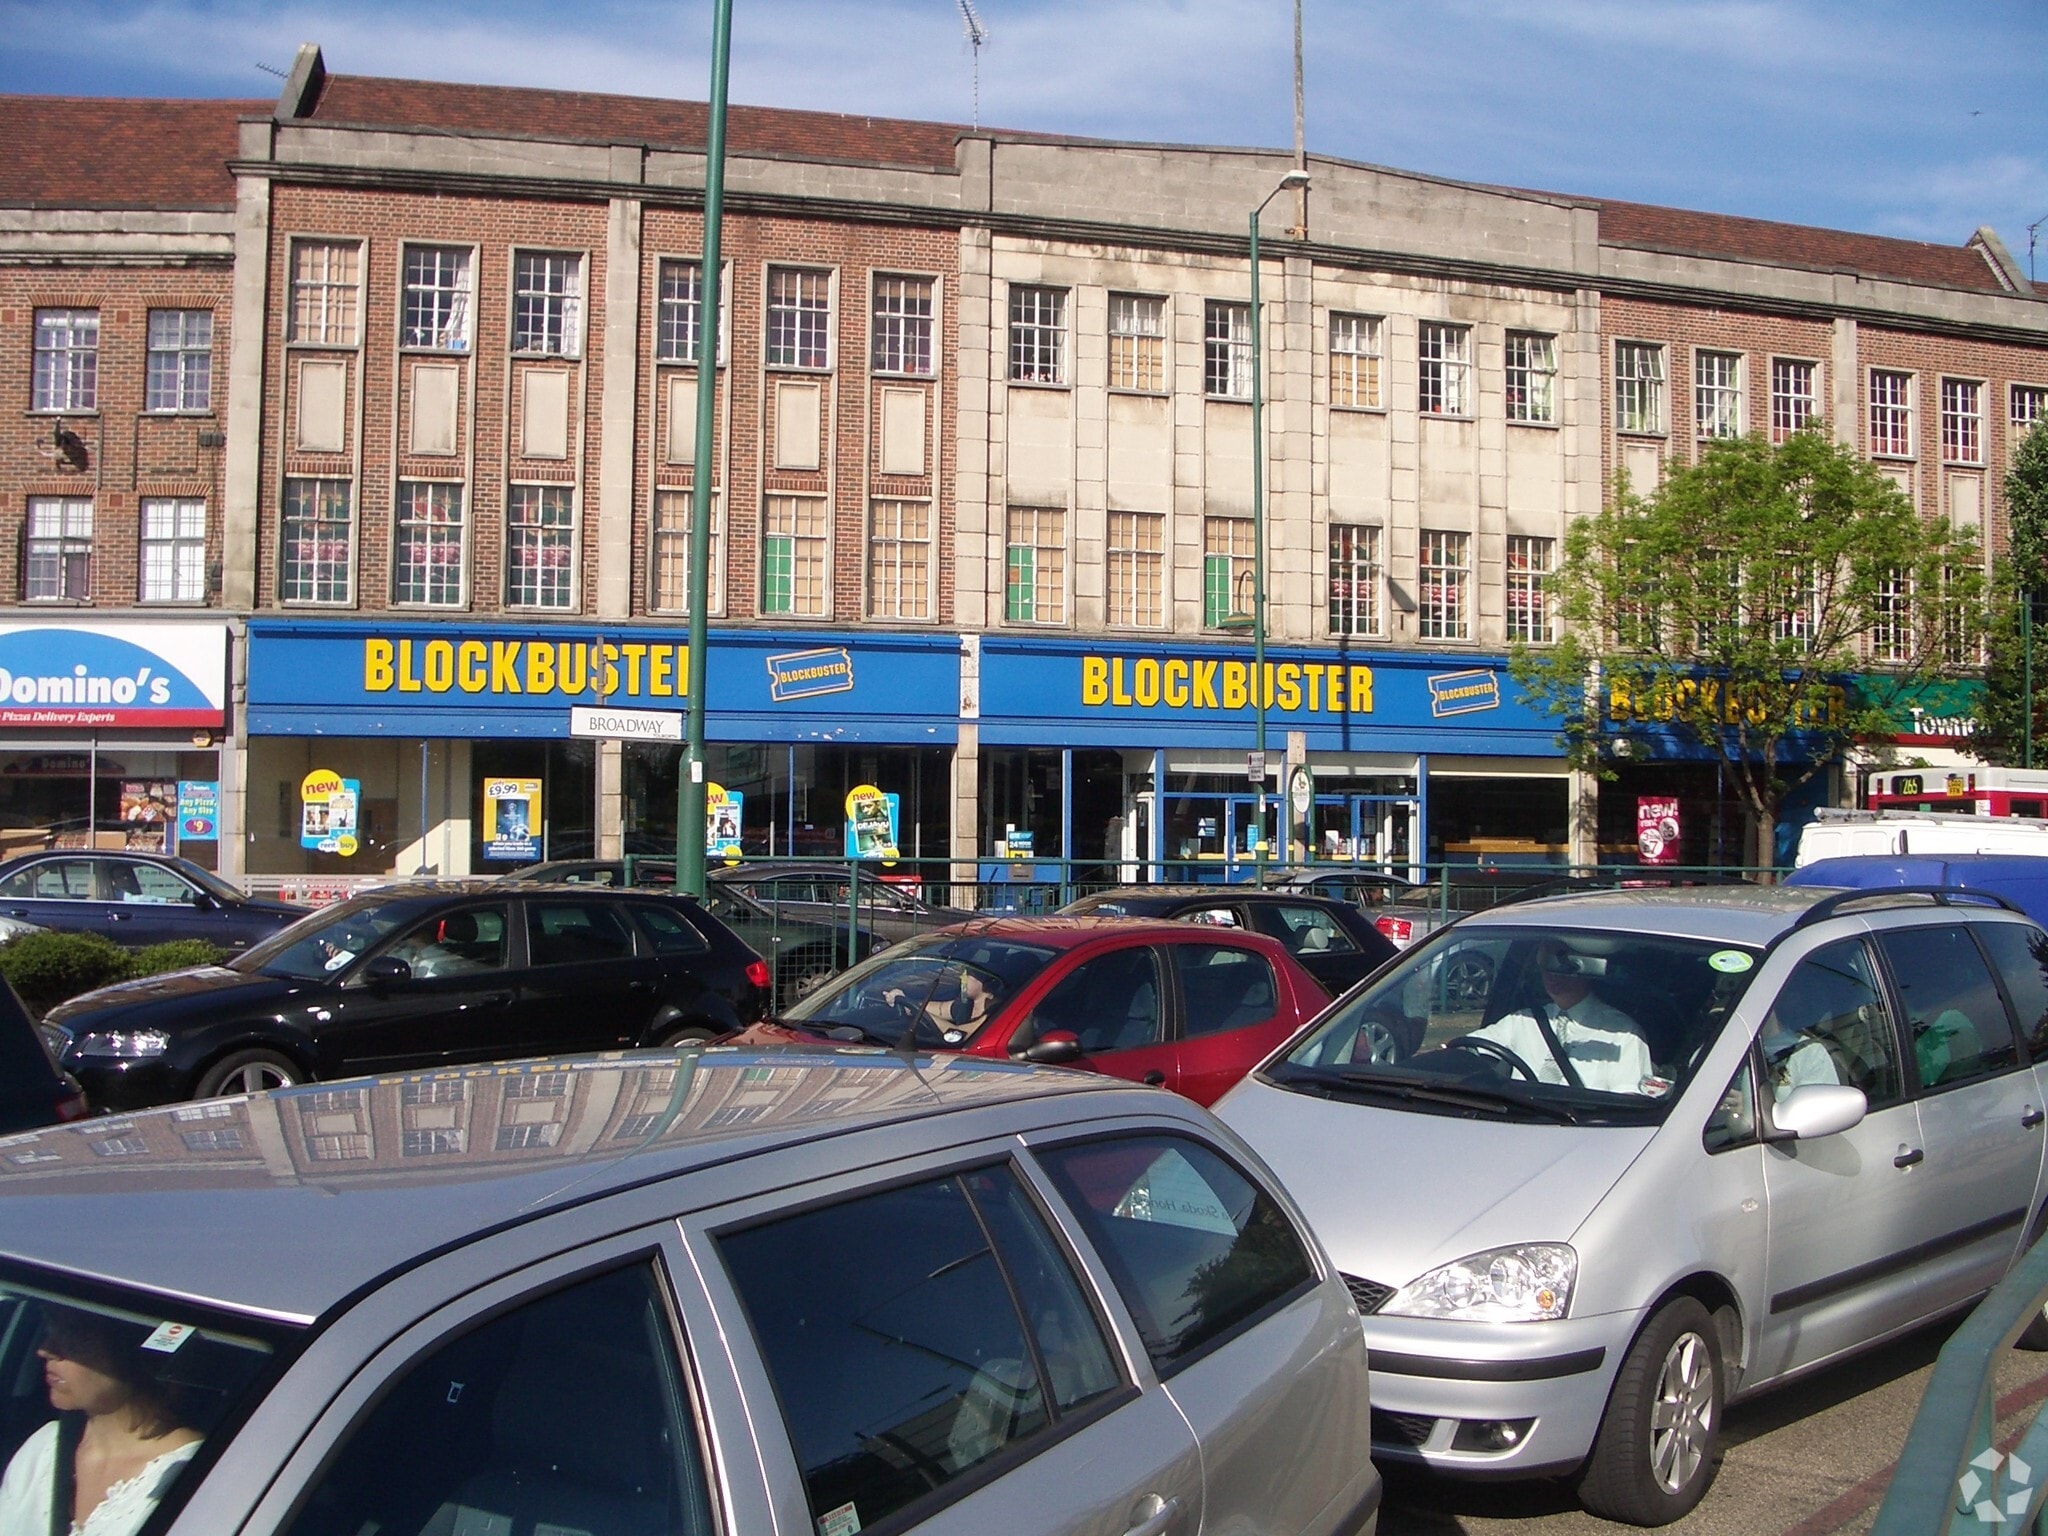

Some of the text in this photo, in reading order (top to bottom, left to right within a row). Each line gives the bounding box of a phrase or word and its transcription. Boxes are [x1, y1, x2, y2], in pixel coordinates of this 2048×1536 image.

[780, 662, 847, 683] BLOCKBUSTER
[1082, 656, 1373, 713] BLOCKBUSTER
[1439, 682, 1494, 701] BLOCKBUSTER
[1609, 677, 1848, 725] BLOCKBUTER
[2, 711, 115, 724] Pizza Delivery Experts
[589, 716, 665, 733] BROADWAY
[305, 780, 339, 795] new
[489, 783, 517, 796] £9.99
[1902, 777, 1918, 795] 265
[705, 793, 724, 805] ew
[852, 791, 876, 801] new
[1639, 798, 1679, 820] new!
